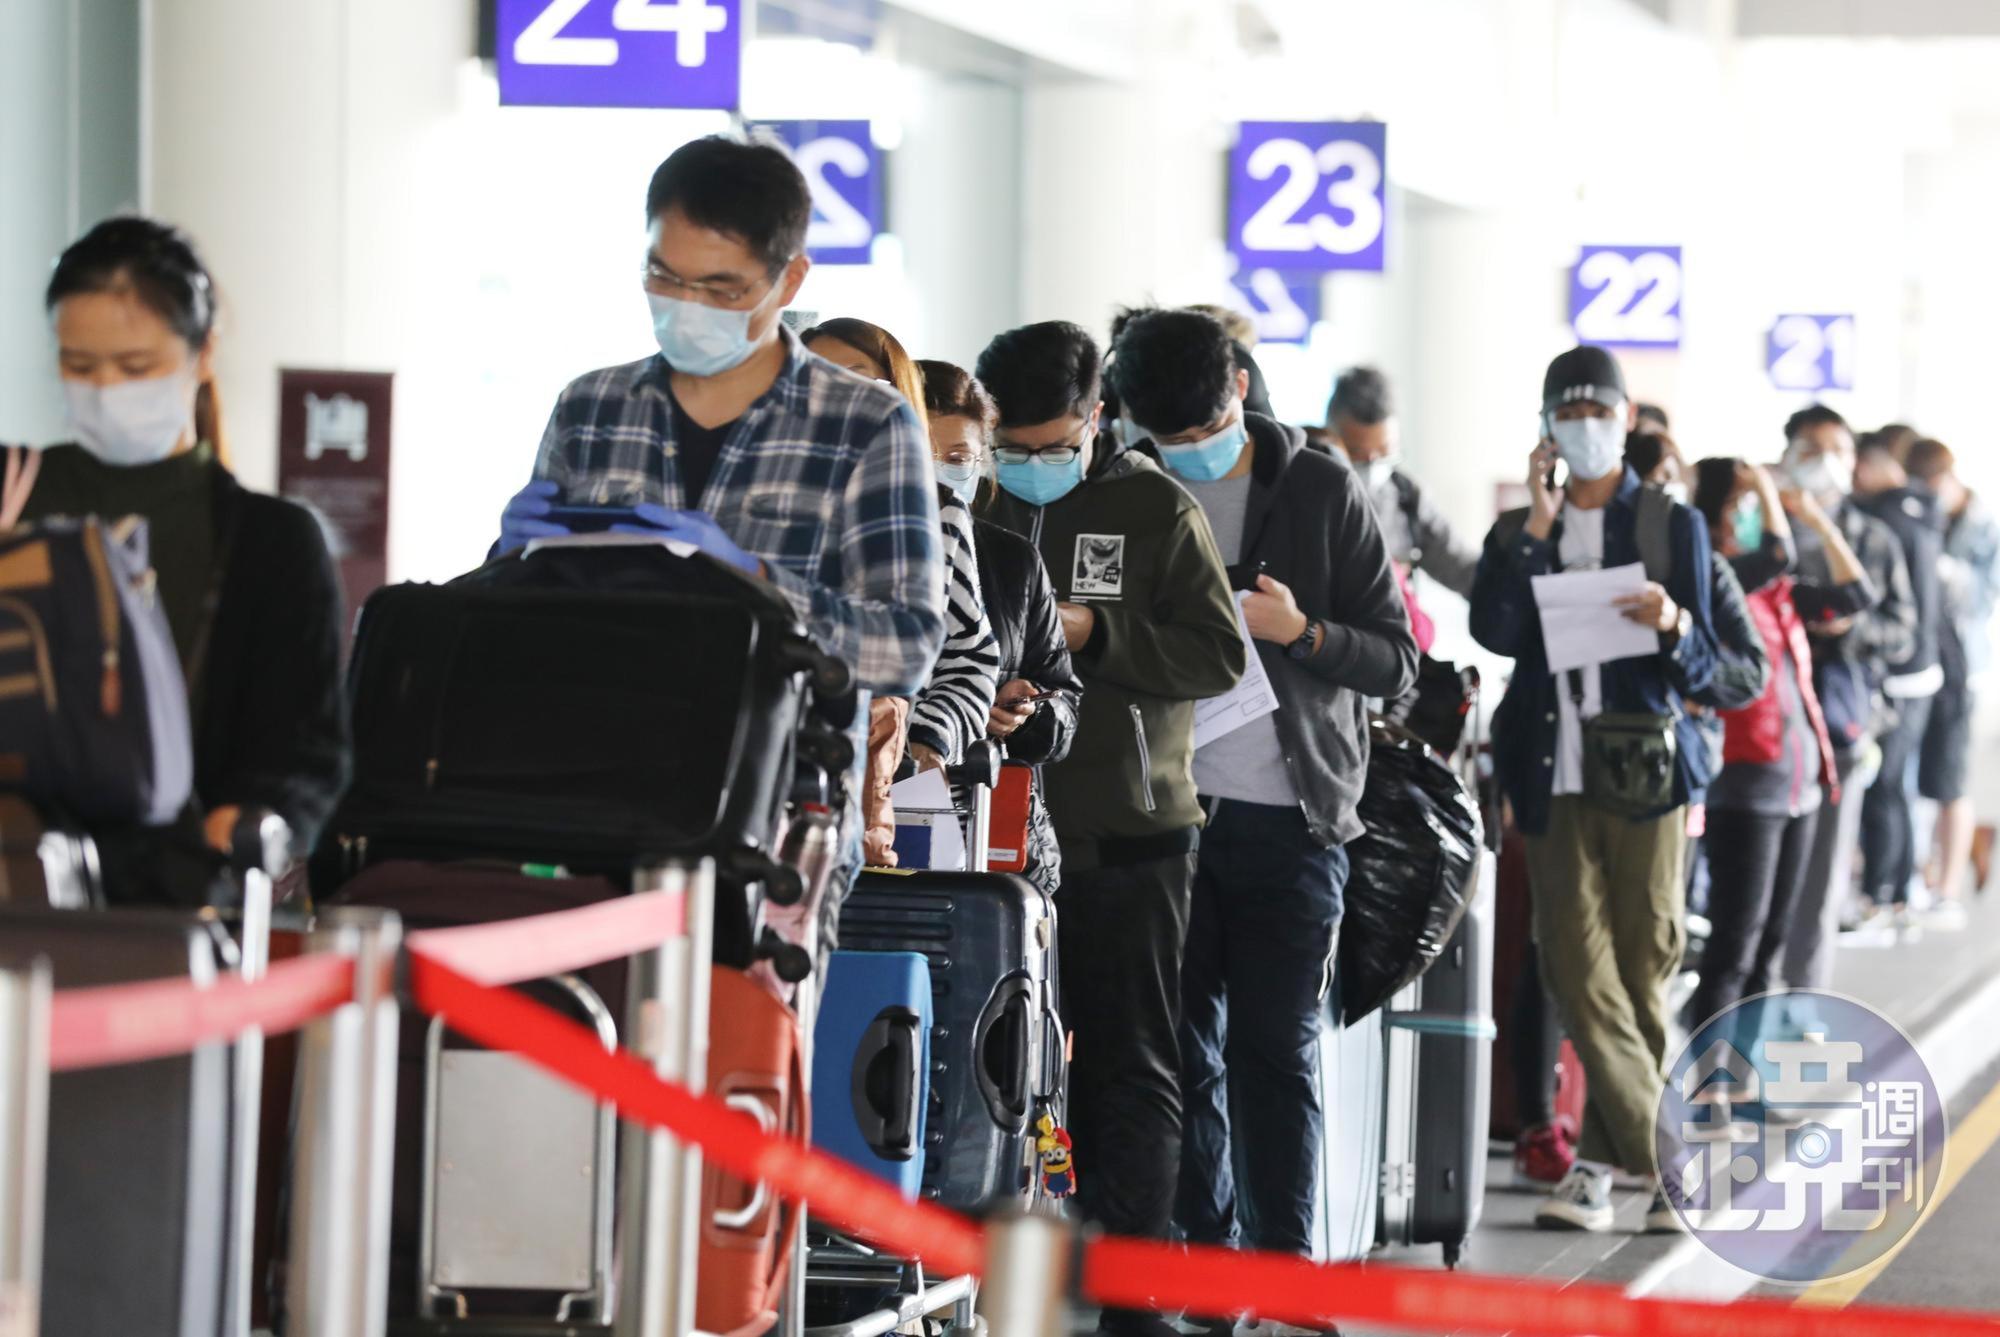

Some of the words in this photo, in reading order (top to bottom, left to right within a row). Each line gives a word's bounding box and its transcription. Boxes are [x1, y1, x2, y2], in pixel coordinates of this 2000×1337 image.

[1241, 137, 1384, 255] 23
[1573, 250, 1681, 342] 22
[1769, 314, 1855, 390] 21
